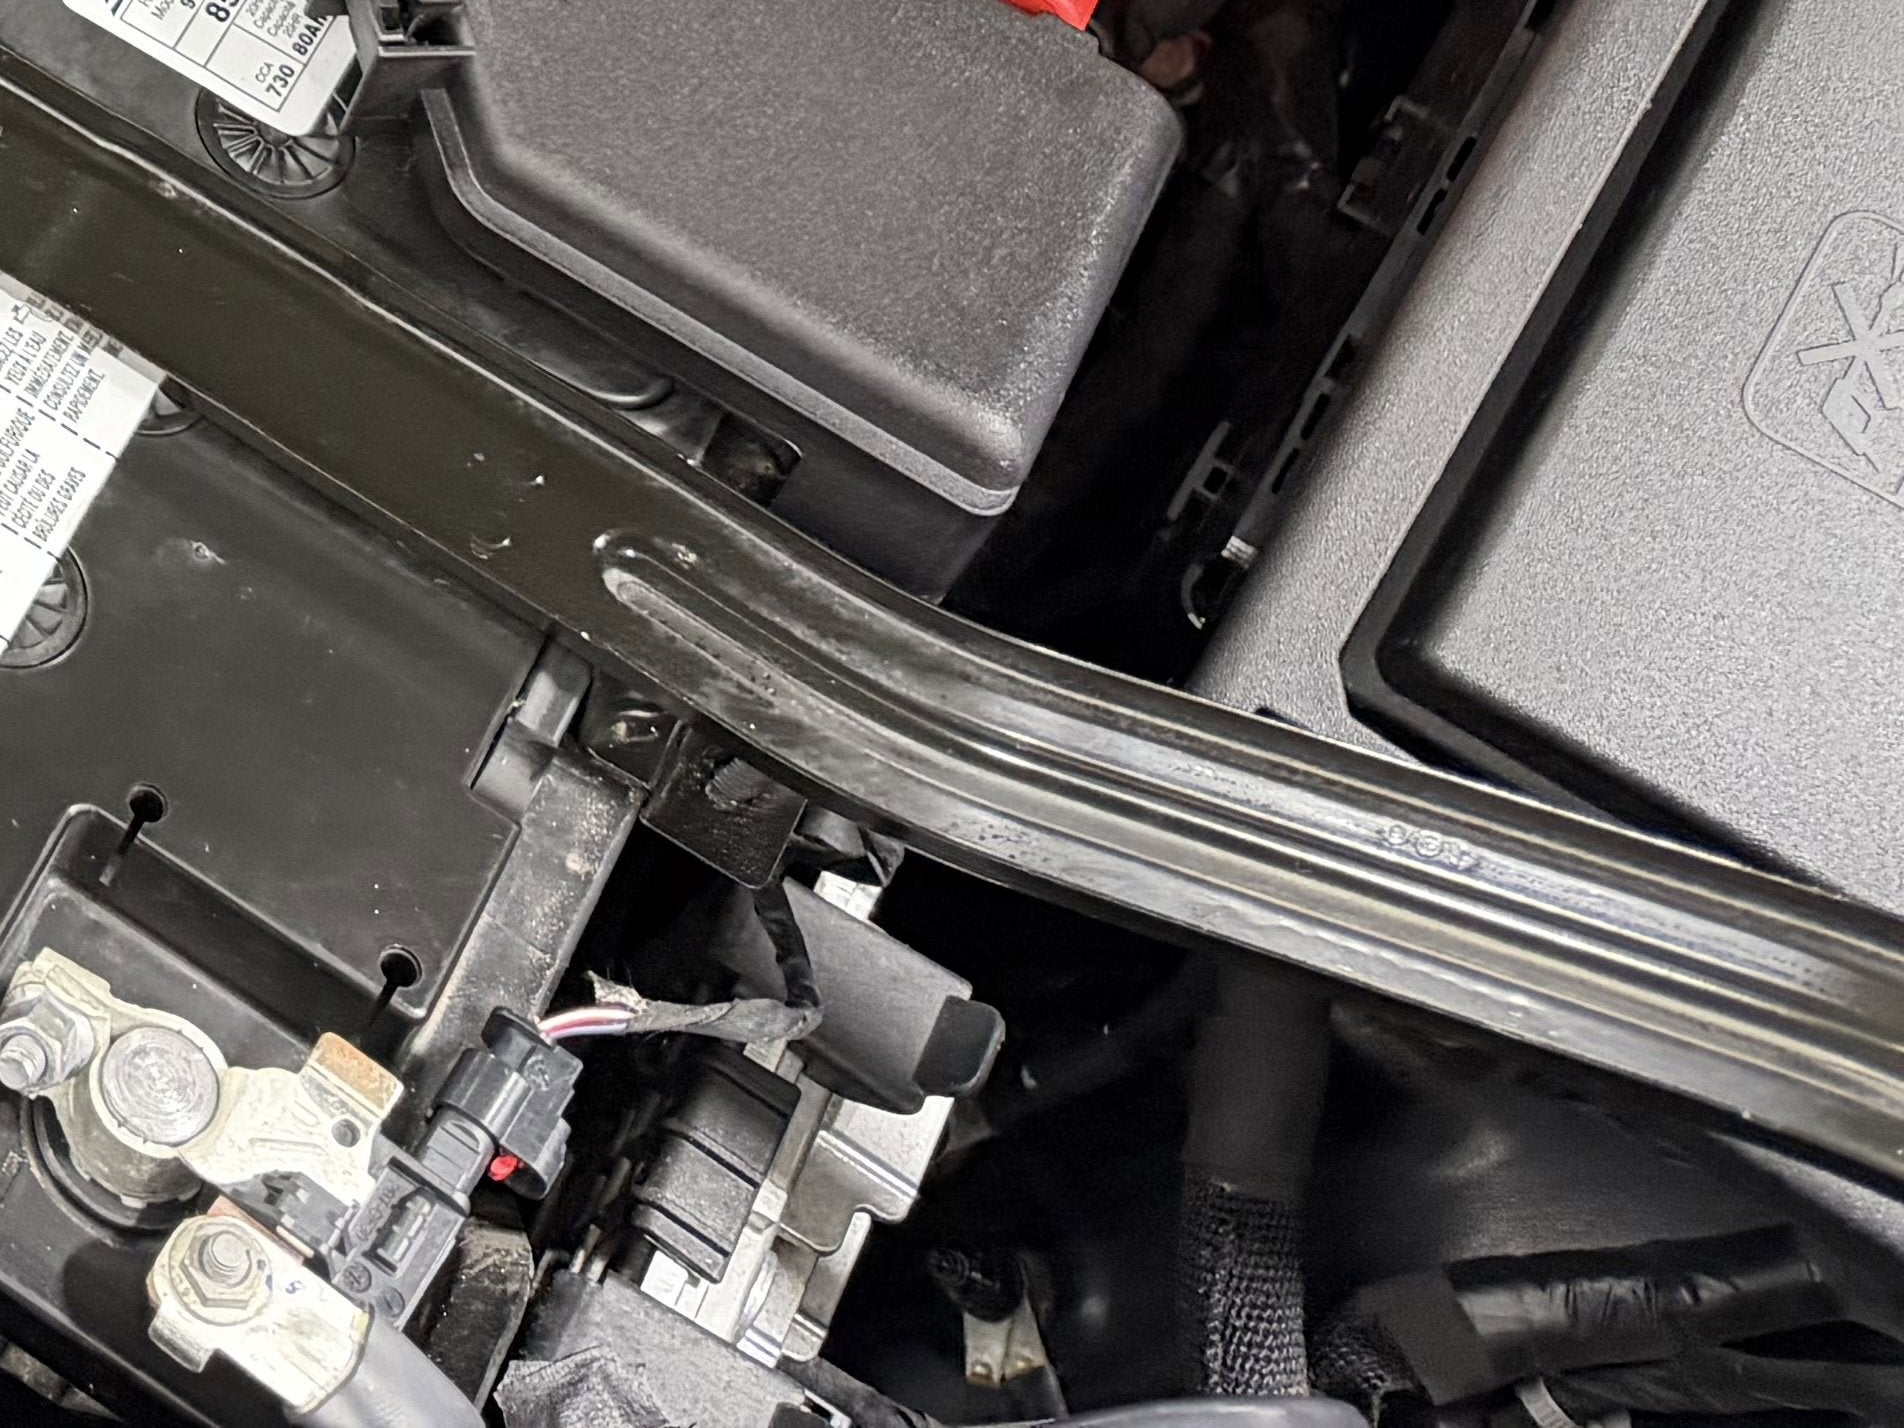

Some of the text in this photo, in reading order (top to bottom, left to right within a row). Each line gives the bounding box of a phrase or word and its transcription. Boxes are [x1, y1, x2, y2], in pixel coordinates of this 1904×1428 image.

[255, 62, 274, 83] CCA
[266, 64, 295, 97] 730
[3, 327, 23, 346] LES
[5, 361, 27, 385] YEUX
[43, 352, 88, 411] CONSULTEZ UN
[22, 449, 39, 463] LA
[35, 469, 55, 490] DES
[57, 467, 86, 500] GRAVES
[28, 489, 46, 502] OU
